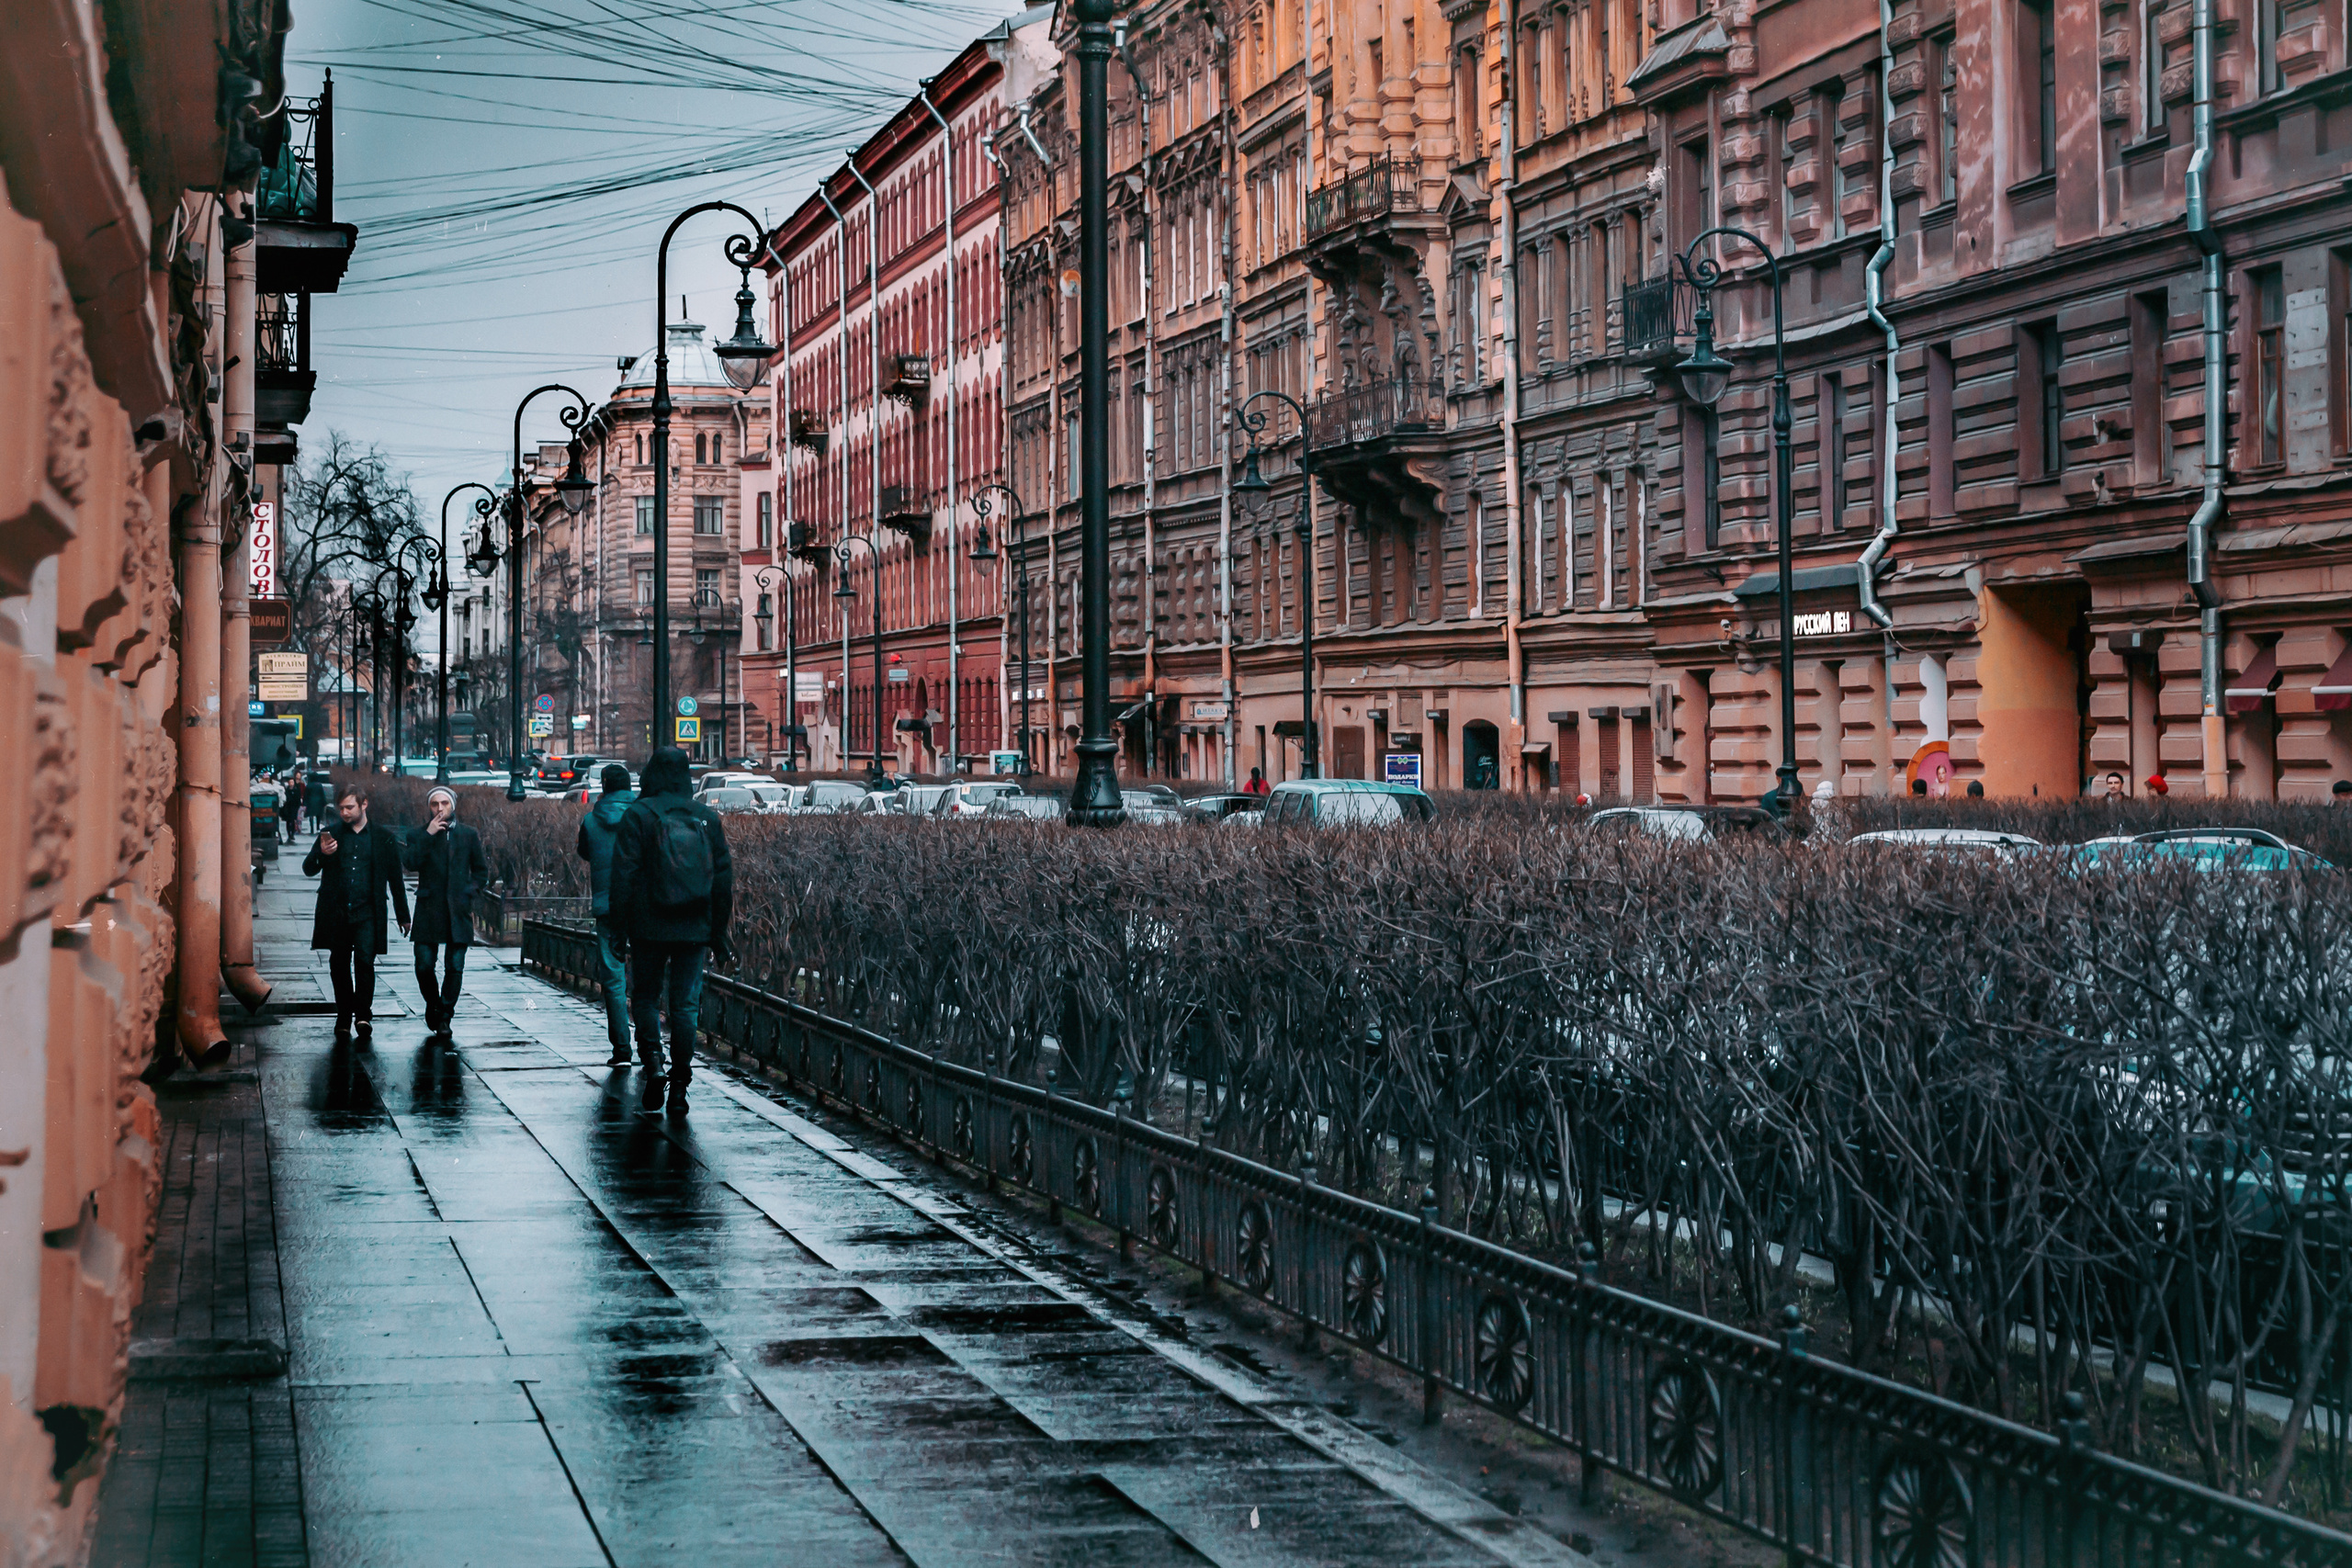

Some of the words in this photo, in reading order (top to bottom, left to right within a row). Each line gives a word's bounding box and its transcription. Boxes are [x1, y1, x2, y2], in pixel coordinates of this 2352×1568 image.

[1793, 611, 1831, 635] РУССКИЙ
[1833, 611, 1850, 633] ЛЕН
[274, 660, 305, 668] ПРАЙМ
